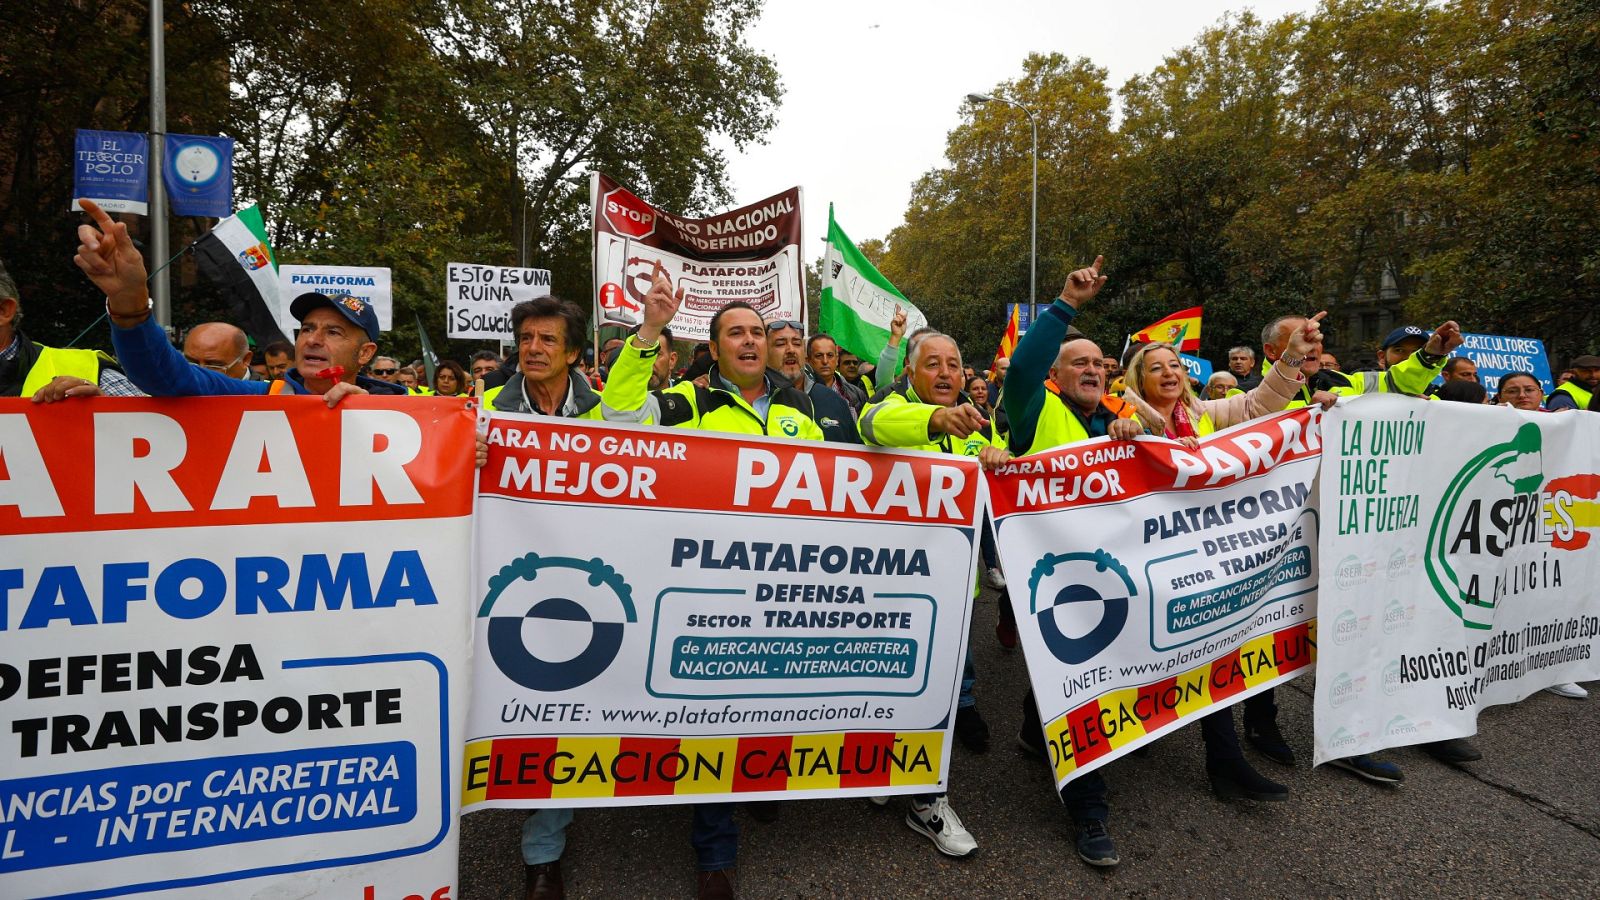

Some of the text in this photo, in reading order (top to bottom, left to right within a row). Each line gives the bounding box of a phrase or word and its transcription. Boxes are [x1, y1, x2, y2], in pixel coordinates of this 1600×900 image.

[102, 140, 121, 151] EL
[85, 163, 134, 175] POLO
[607, 200, 652, 225] STOP
[706, 197, 794, 237] NACIONAL
[679, 224, 778, 250] INDEFINIDO
[291, 275, 376, 287] PLATAFORMA
[449, 266, 551, 286] ESTO ES UNA
[681, 261, 777, 277] PLATAFORMA
[712, 279, 757, 287] DEFENSA
[716, 282, 773, 296] TRANSPORTE
[1467, 351, 1535, 373] GANADEROS
[487, 427, 687, 461] ARA NO GANAR
[1341, 410, 1426, 456] LA UNIÓN
[994, 444, 1137, 476] PARA NO GANAR
[1016, 406, 1323, 507] MEJOR PARAR
[498, 447, 967, 521] MEJOR PARAR
[1339, 458, 1390, 496] HACE
[1143, 482, 1311, 545] PLATAFORM
[1338, 494, 1420, 536] LA FUERZA
[1201, 522, 1288, 558] DEFENSA
[670, 537, 932, 577] PLATAFORMA
[754, 582, 867, 605] DEFENSA
[1171, 569, 1216, 590] SECTOR
[1172, 601, 1187, 613] de
[1189, 579, 1253, 610] MERCANCIAS
[1253, 577, 1268, 590] por
[686, 610, 912, 630] SECTOR TRANSPORTE
[1171, 604, 1232, 630] NACIONAL
[1564, 616, 1579, 641] de
[680, 641, 911, 658] de MERCANCIAS por CARRETERA
[1062, 603, 1305, 699] ÚNETE: www.plataformanacional.es
[1526, 642, 1592, 673] independientes
[677, 659, 768, 676] NACIONAL
[782, 658, 909, 675] INTERNACIONAL
[11, 688, 402, 759] TRANSPORTE
[499, 698, 896, 729] ÚNETE: www.plataformanacional.es
[465, 738, 934, 792] ELEGACIÓN CATALUÑA
[128, 776, 193, 814] por
[202, 755, 400, 800] CARRETERA
[95, 788, 401, 849] INTERNACIONAL
